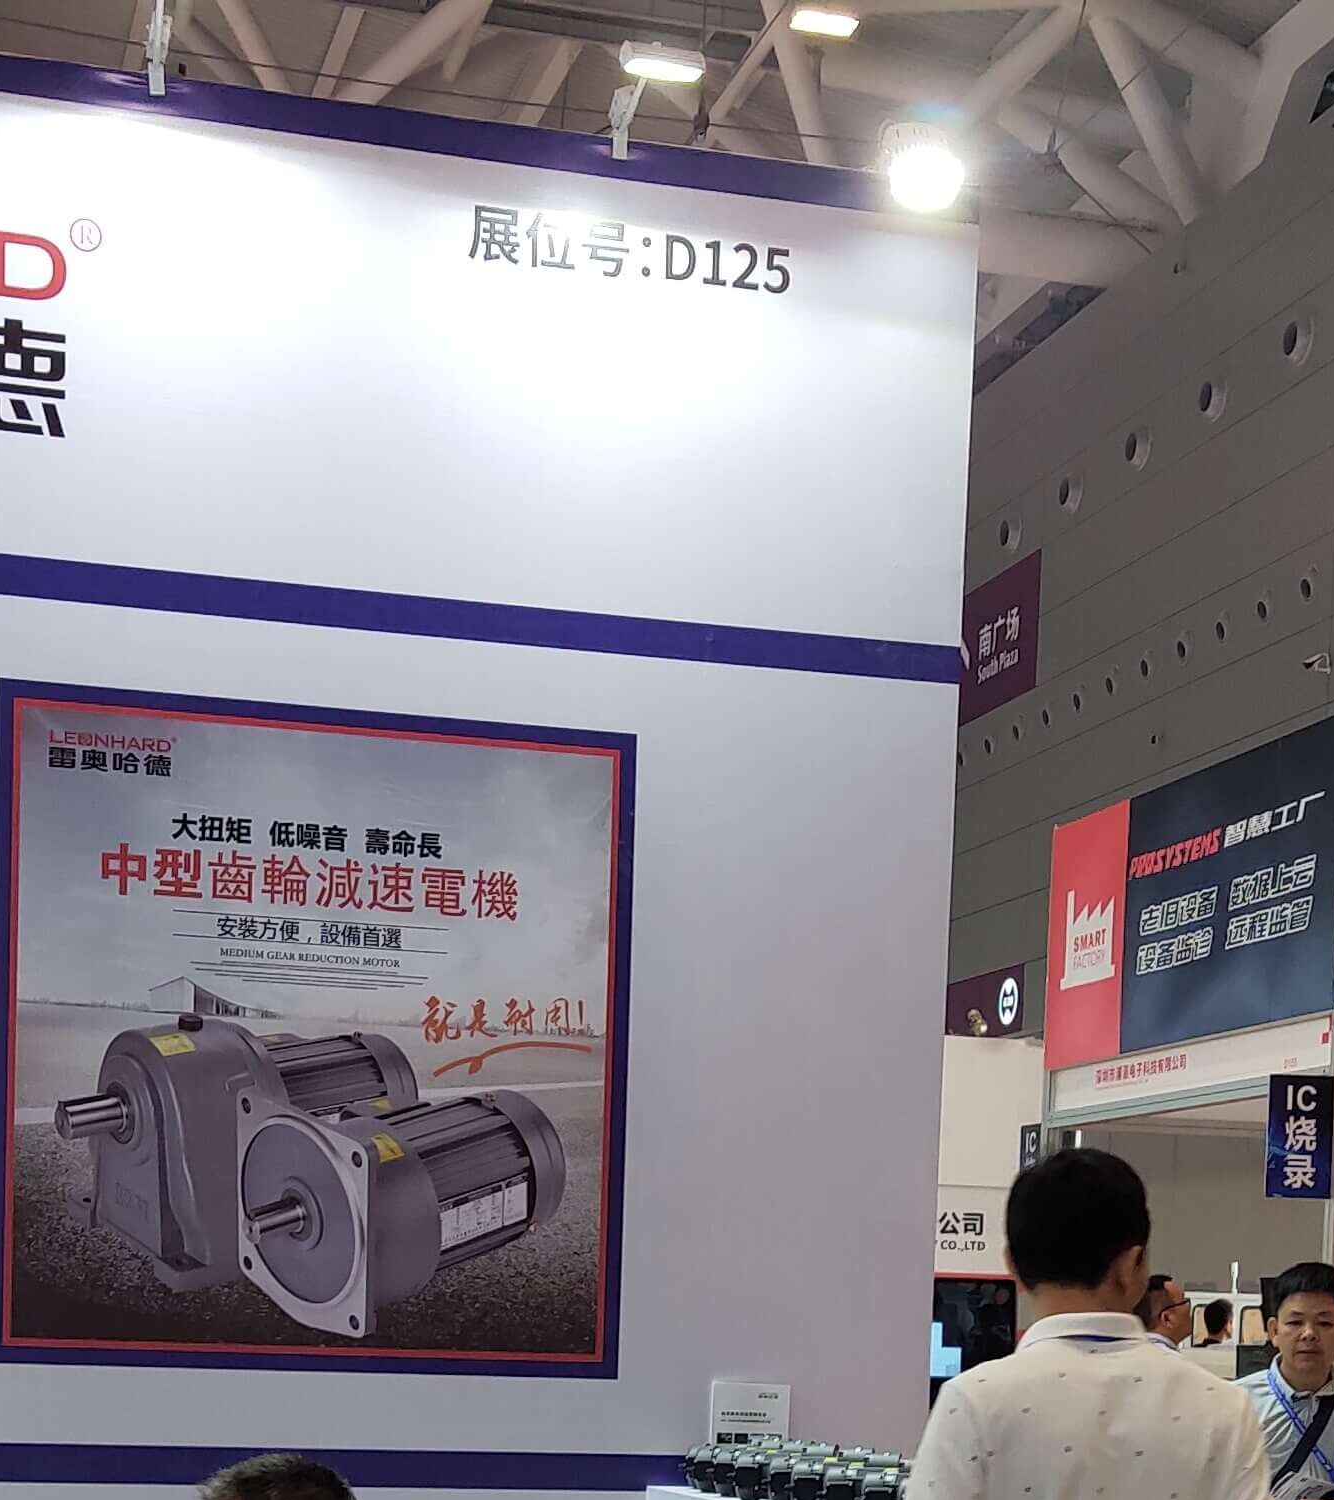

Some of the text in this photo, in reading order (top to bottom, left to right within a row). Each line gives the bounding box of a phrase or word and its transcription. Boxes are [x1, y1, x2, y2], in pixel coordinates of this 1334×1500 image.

[979, 606, 1020, 660] 南广场
[977, 648, 1019, 685] South Plaza
[49, 729, 172, 752] LEONHARD
[49, 746, 171, 777] 雷奥哈德
[172, 813, 443, 860] 大扭矩 低噪音 壽命長
[1073, 928, 1107, 953] SMART
[220, 948, 400, 968] MEDIUM GEAR REDUCTION MOTOR
[1286, 1084, 1318, 1111] IC
[1025, 1131, 1037, 1152] IC
[1283, 1115, 1318, 1190] 烧录
[939, 1212, 984, 1236] 公司
[940, 1240, 986, 1252] CO.,LTD
